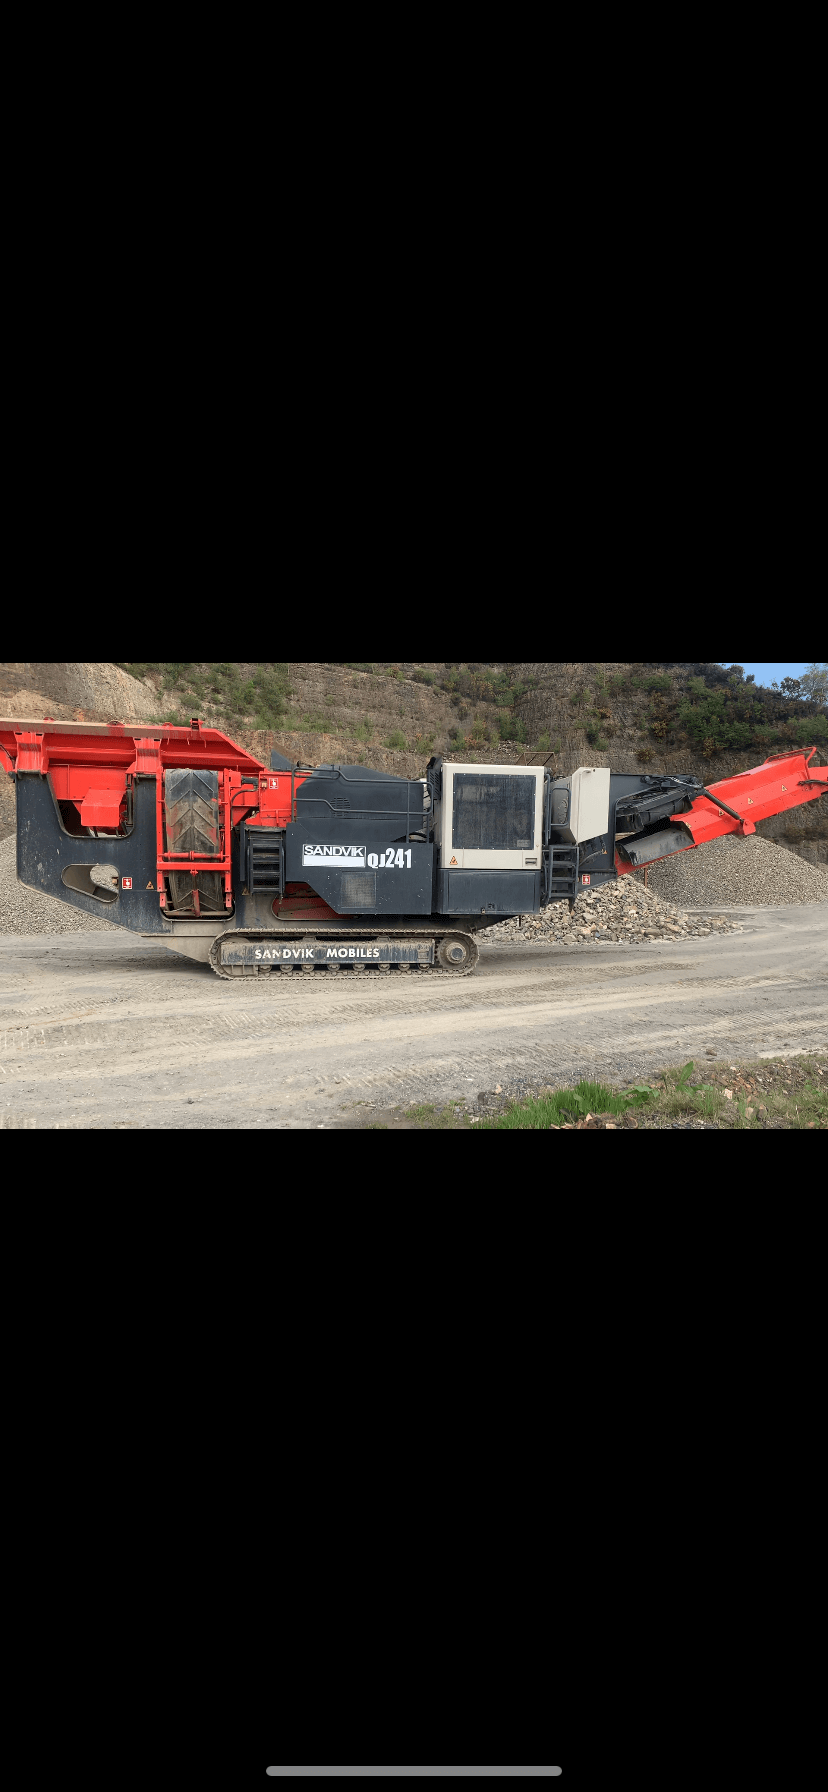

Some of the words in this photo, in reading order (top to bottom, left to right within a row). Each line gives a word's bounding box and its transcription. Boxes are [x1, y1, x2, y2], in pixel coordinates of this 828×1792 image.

[304, 845, 363, 856] SANDVIK
[367, 848, 412, 868] QJ241
[254, 948, 314, 959] SANDVIK
[326, 948, 380, 958] MOBILES
